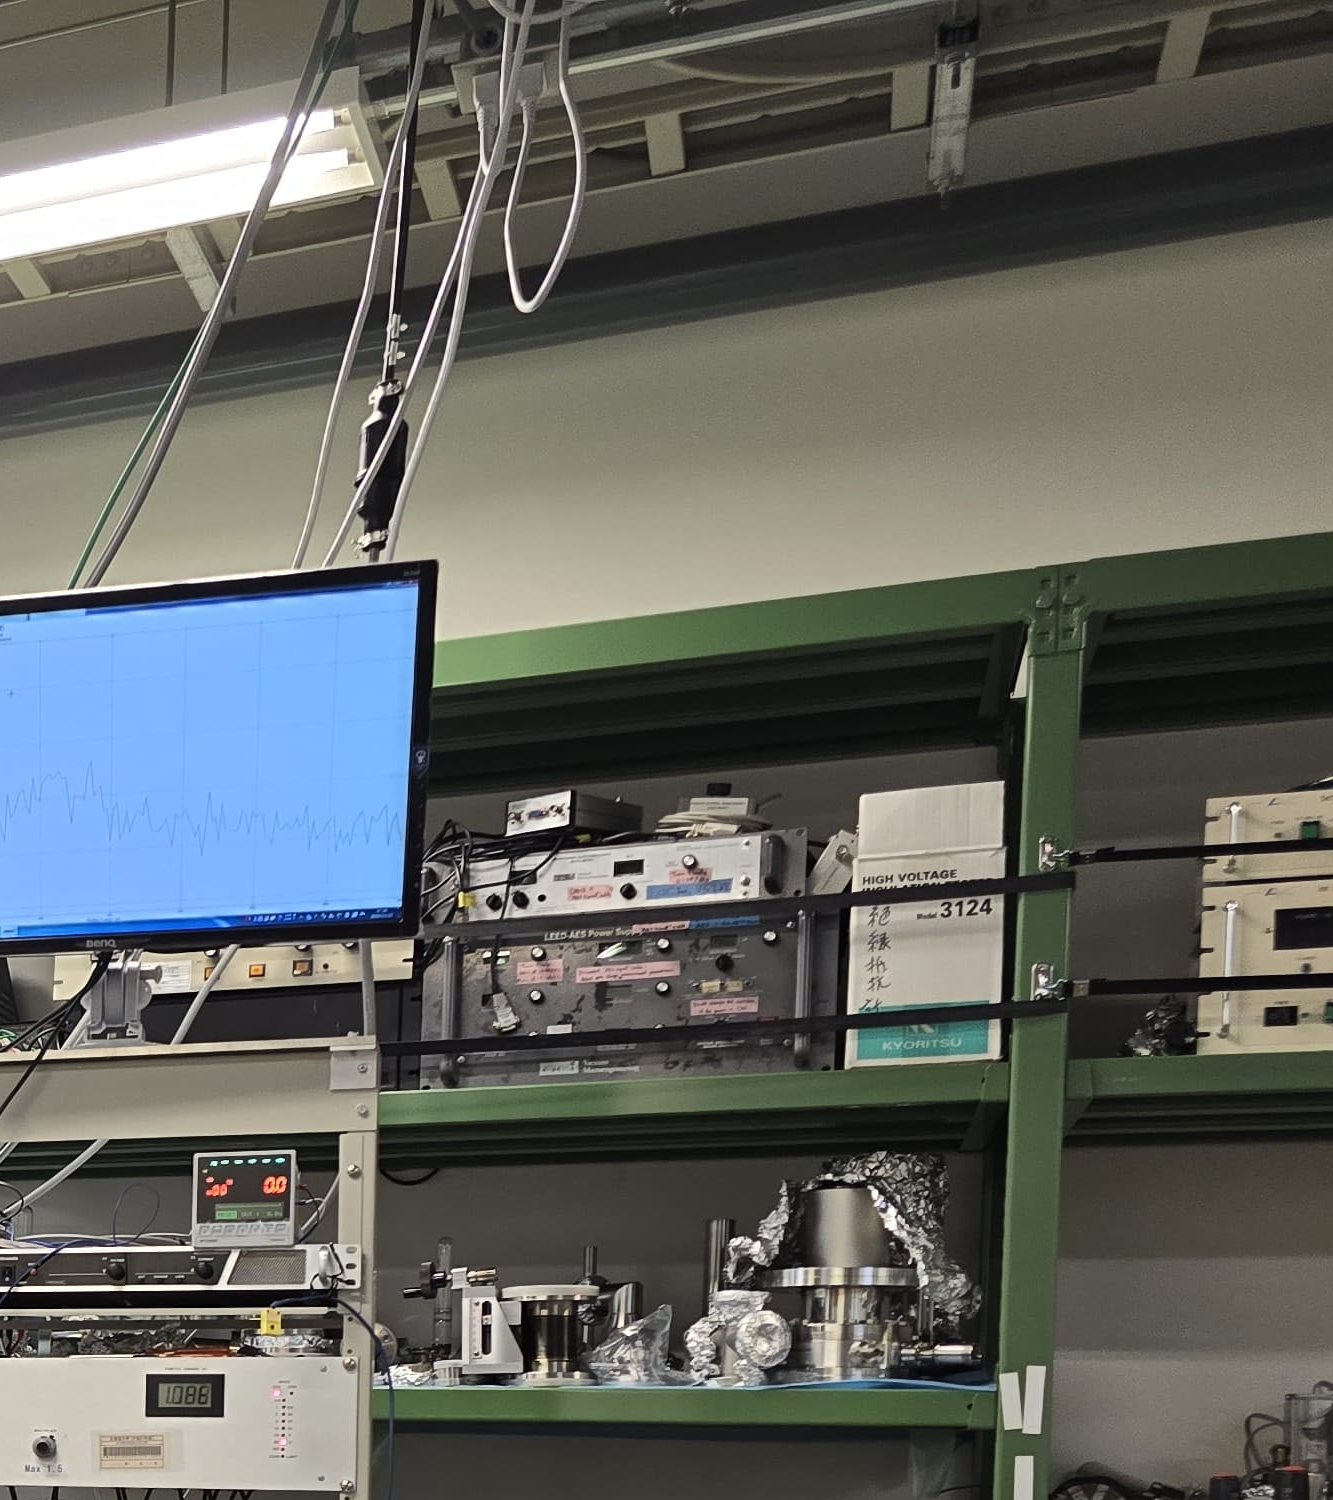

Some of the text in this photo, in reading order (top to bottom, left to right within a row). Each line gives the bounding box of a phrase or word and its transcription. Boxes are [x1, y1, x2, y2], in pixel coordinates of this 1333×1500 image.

[863, 874, 893, 885] HIGH
[898, 869, 958, 883] VOLTAGE
[916, 898, 993, 920] Model 3124
[86, 939, 117, 948] BenQ
[883, 1037, 963, 1051] KYORITSU
[25, 1464, 63, 1473] Max 1.5
